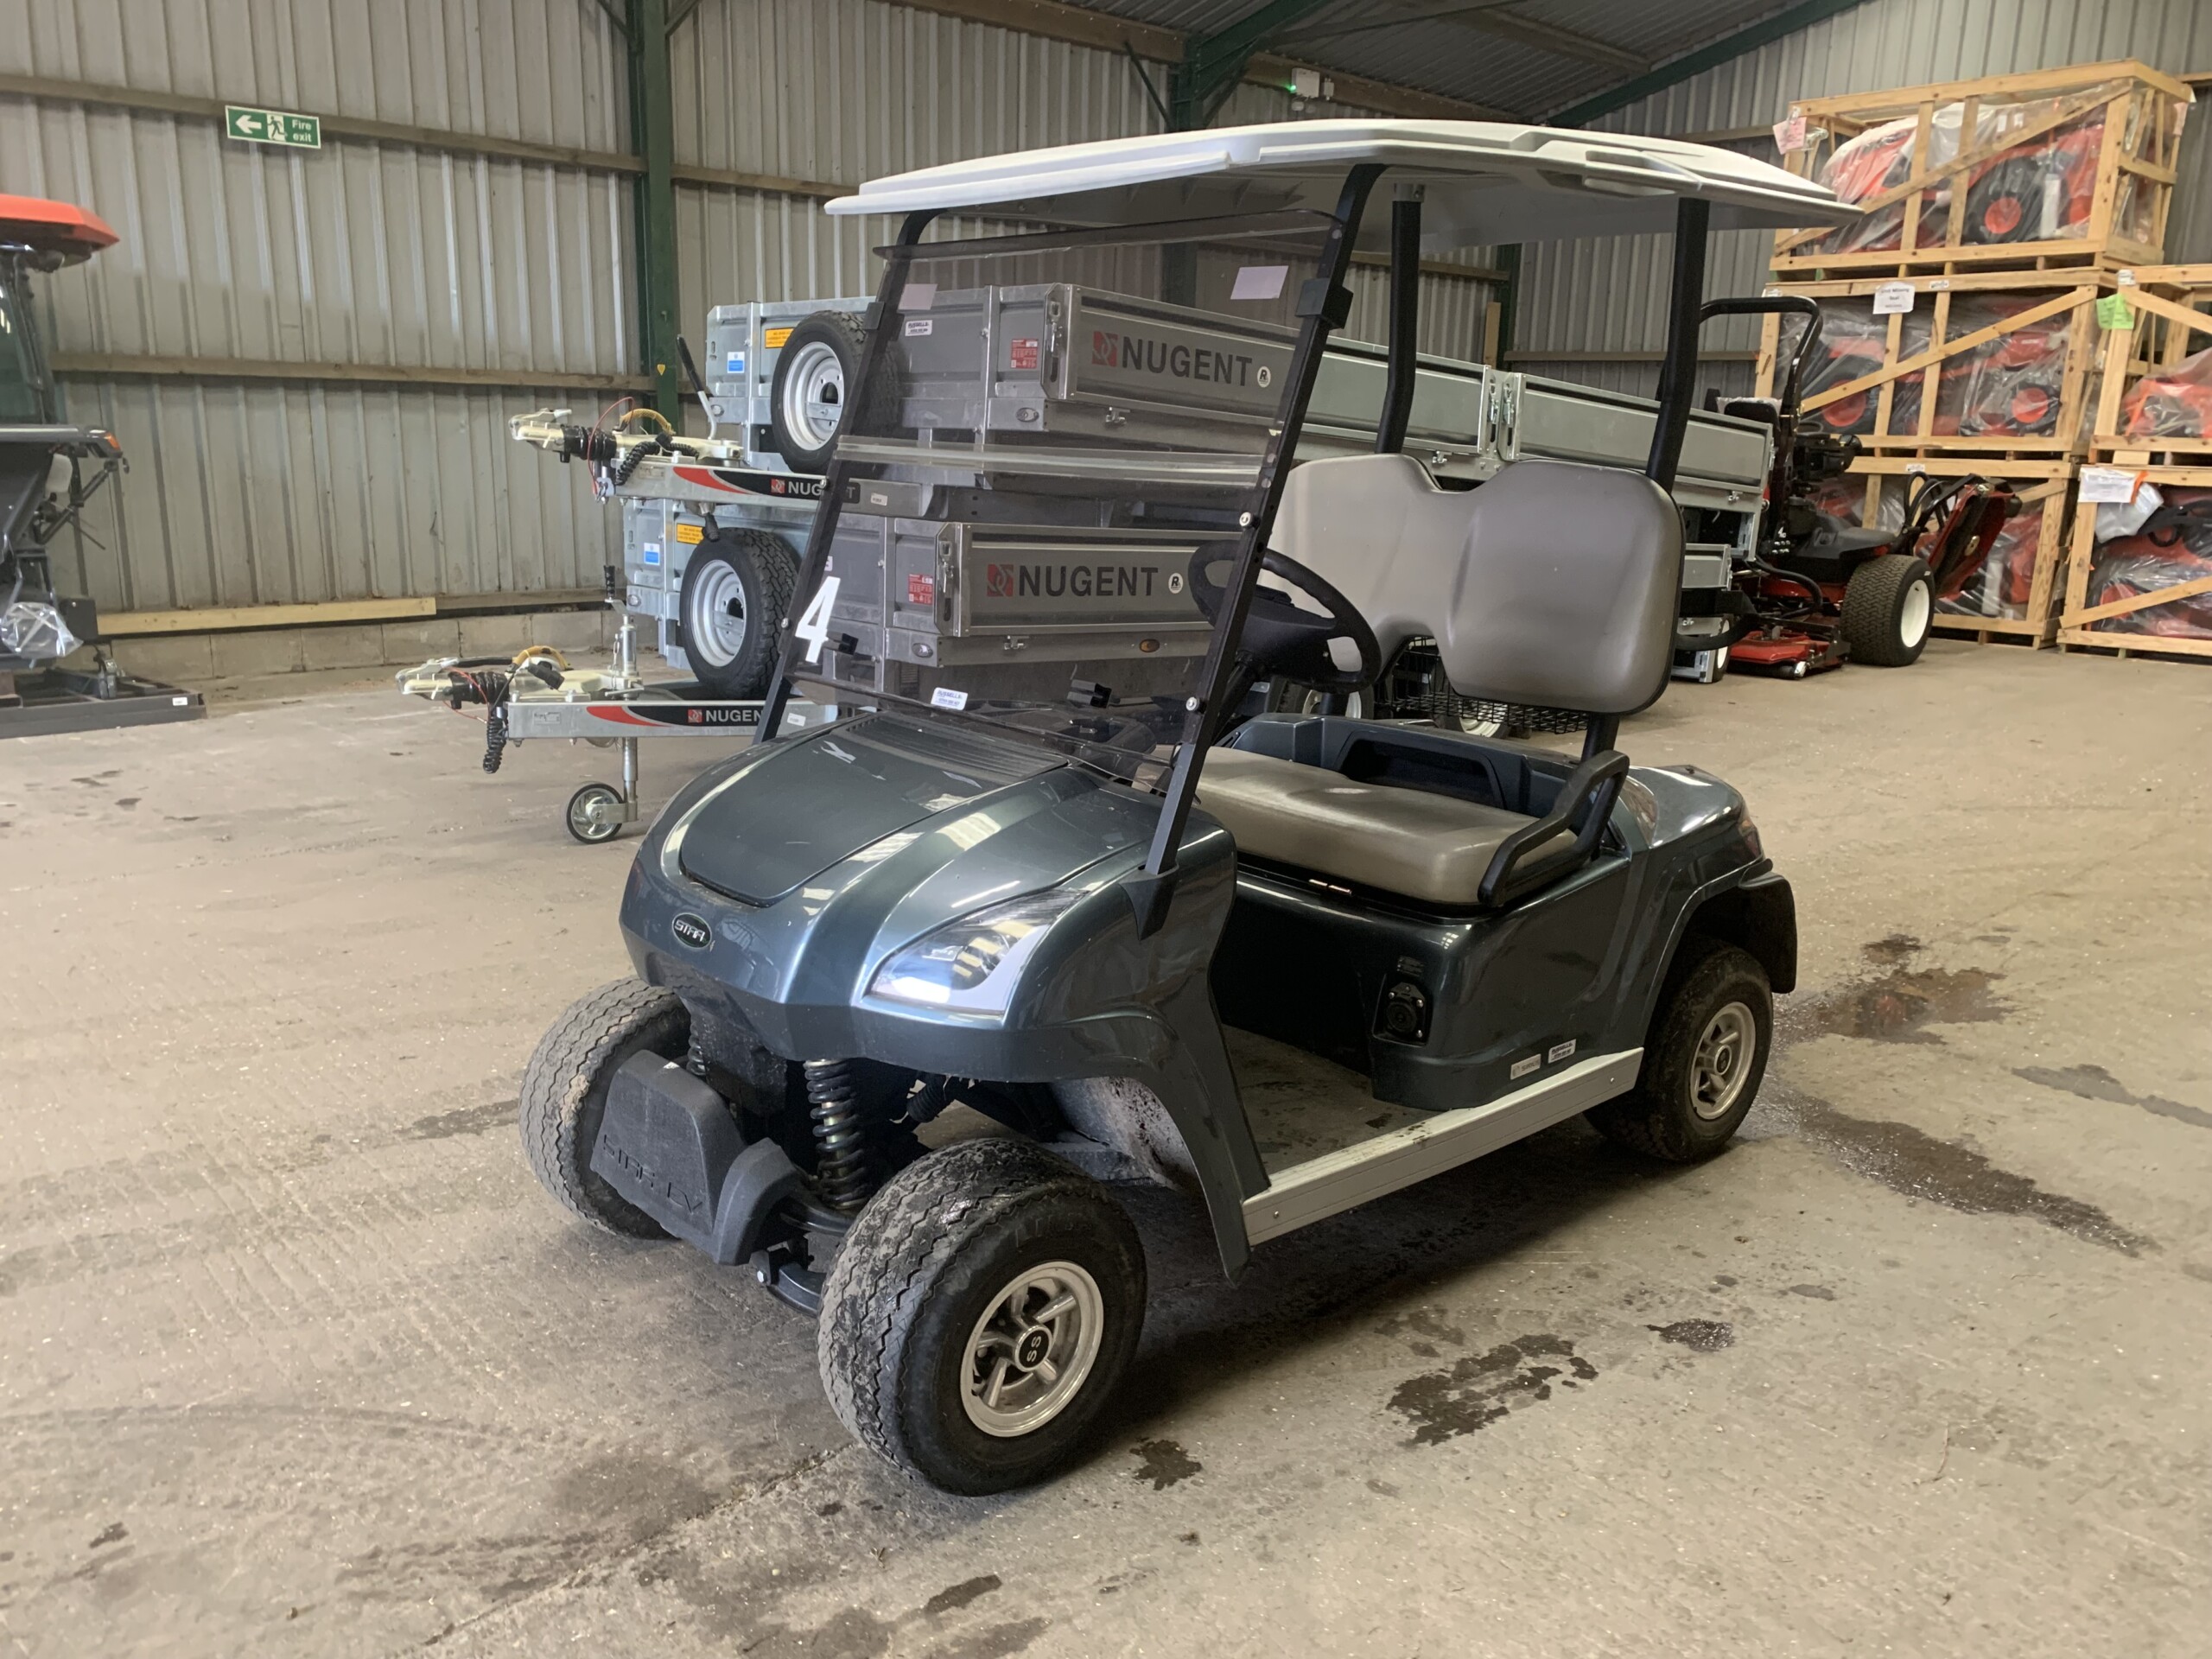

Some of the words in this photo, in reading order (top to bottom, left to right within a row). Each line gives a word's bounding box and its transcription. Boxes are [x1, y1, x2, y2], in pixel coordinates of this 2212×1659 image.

[292, 119, 312, 130] Fire
[293, 132, 312, 143] exit
[1122, 335, 1253, 387] NUGENT
[1019, 565, 1159, 597] NUGENT
[795, 575, 841, 663] 4
[674, 918, 706, 943] STAR
